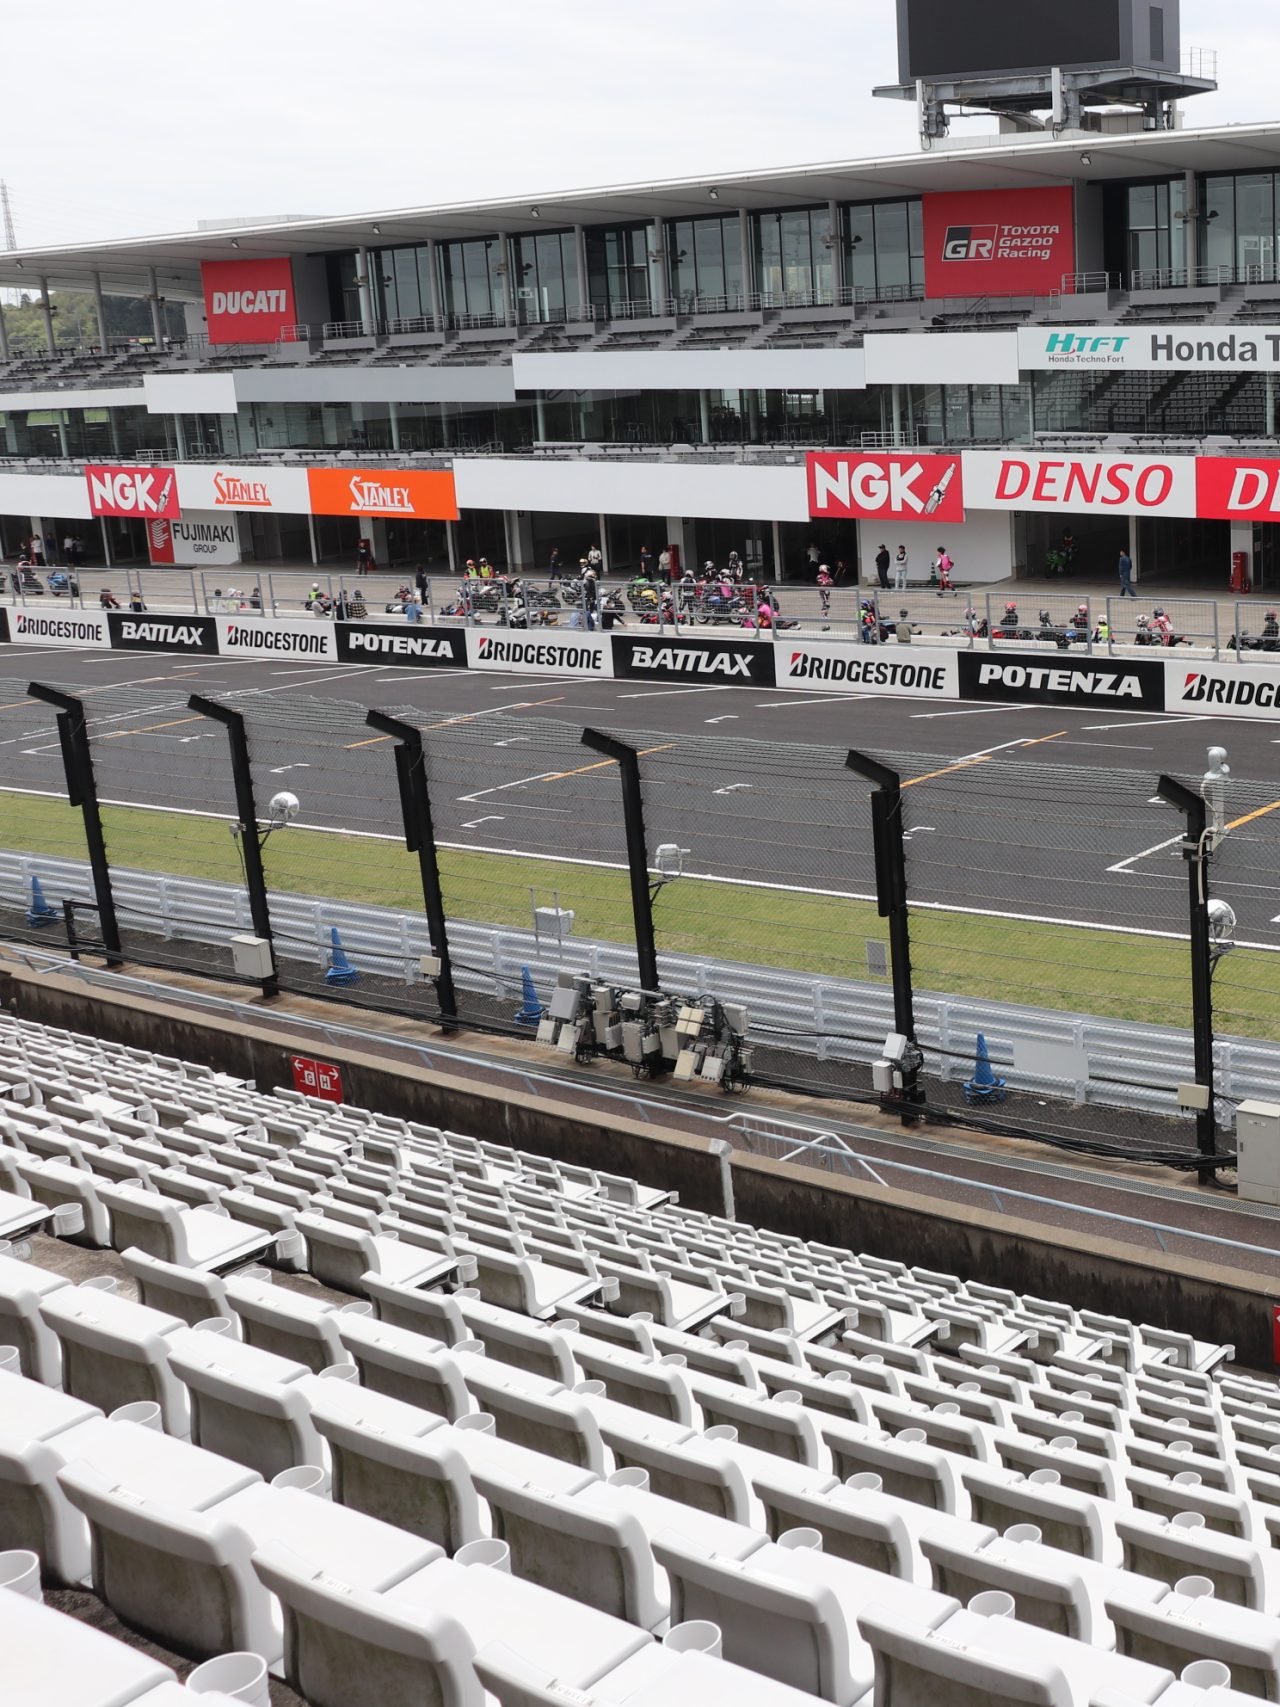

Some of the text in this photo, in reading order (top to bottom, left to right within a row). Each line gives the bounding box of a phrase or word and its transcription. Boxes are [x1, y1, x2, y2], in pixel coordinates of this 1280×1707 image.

[999, 237, 1052, 246] GAZOO
[1002, 226, 1059, 235] TOYOTA
[945, 239, 992, 259] GR
[998, 249, 1050, 259] Racing
[213, 290, 285, 314] DUCATI
[1045, 333, 1130, 353] HTFT
[1151, 335, 1257, 361] Honda
[1048, 354, 1125, 363] Honda Techno Fort
[90, 472, 158, 514] NGK
[214, 472, 272, 506] STANLEY
[349, 476, 415, 512] STANLEY
[814, 461, 926, 514] NGK
[995, 460, 1173, 506] DENSO
[172, 522, 235, 543] FUJIMAKI
[193, 544, 217, 553] GROUP
[17, 615, 102, 641] BRIDGESTONE
[226, 625, 328, 655] BRIDGESTONE
[349, 632, 453, 658] POTENZA
[478, 637, 603, 671] BRIDGESTONE
[789, 652, 947, 690] BRIDGESTONE
[978, 664, 1143, 698] POTENZA
